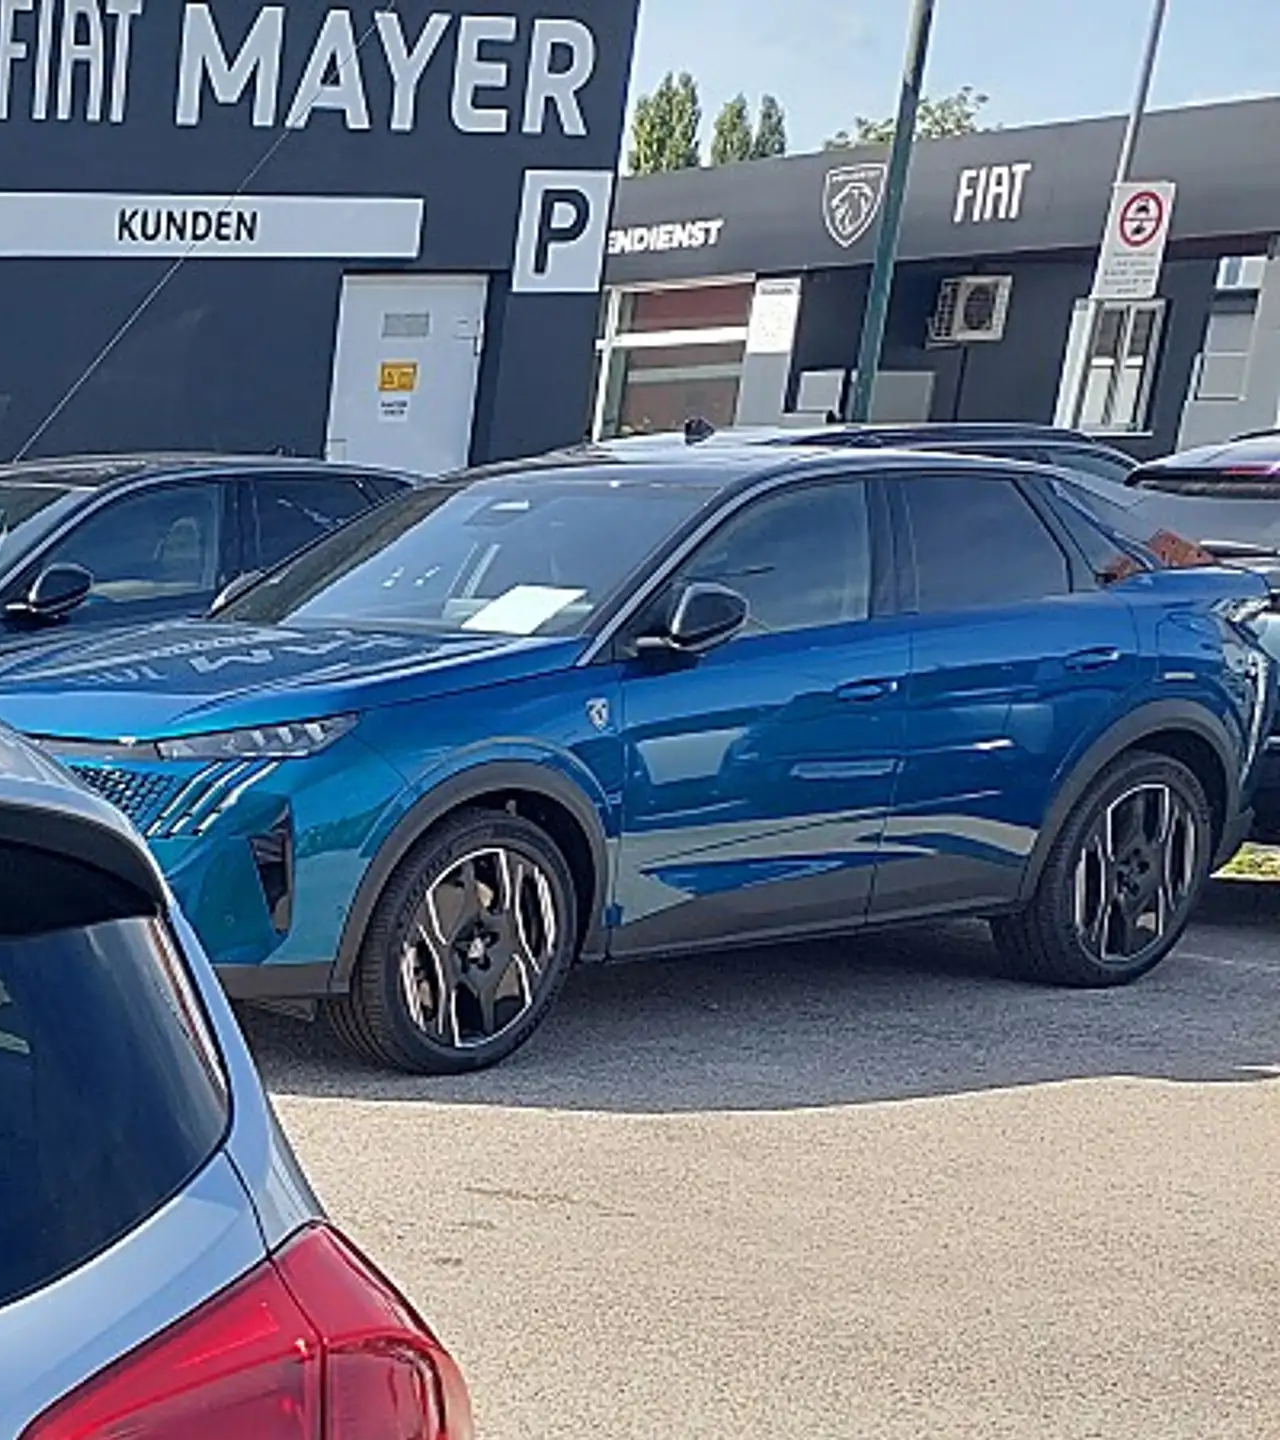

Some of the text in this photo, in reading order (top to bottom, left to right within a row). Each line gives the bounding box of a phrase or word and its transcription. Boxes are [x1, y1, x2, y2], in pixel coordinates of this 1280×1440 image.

[175, 2, 597, 137] MAYER
[118, 207, 258, 242] KUNDEN
[953, 162, 1032, 224] FIAT
[532, 188, 591, 276] P
